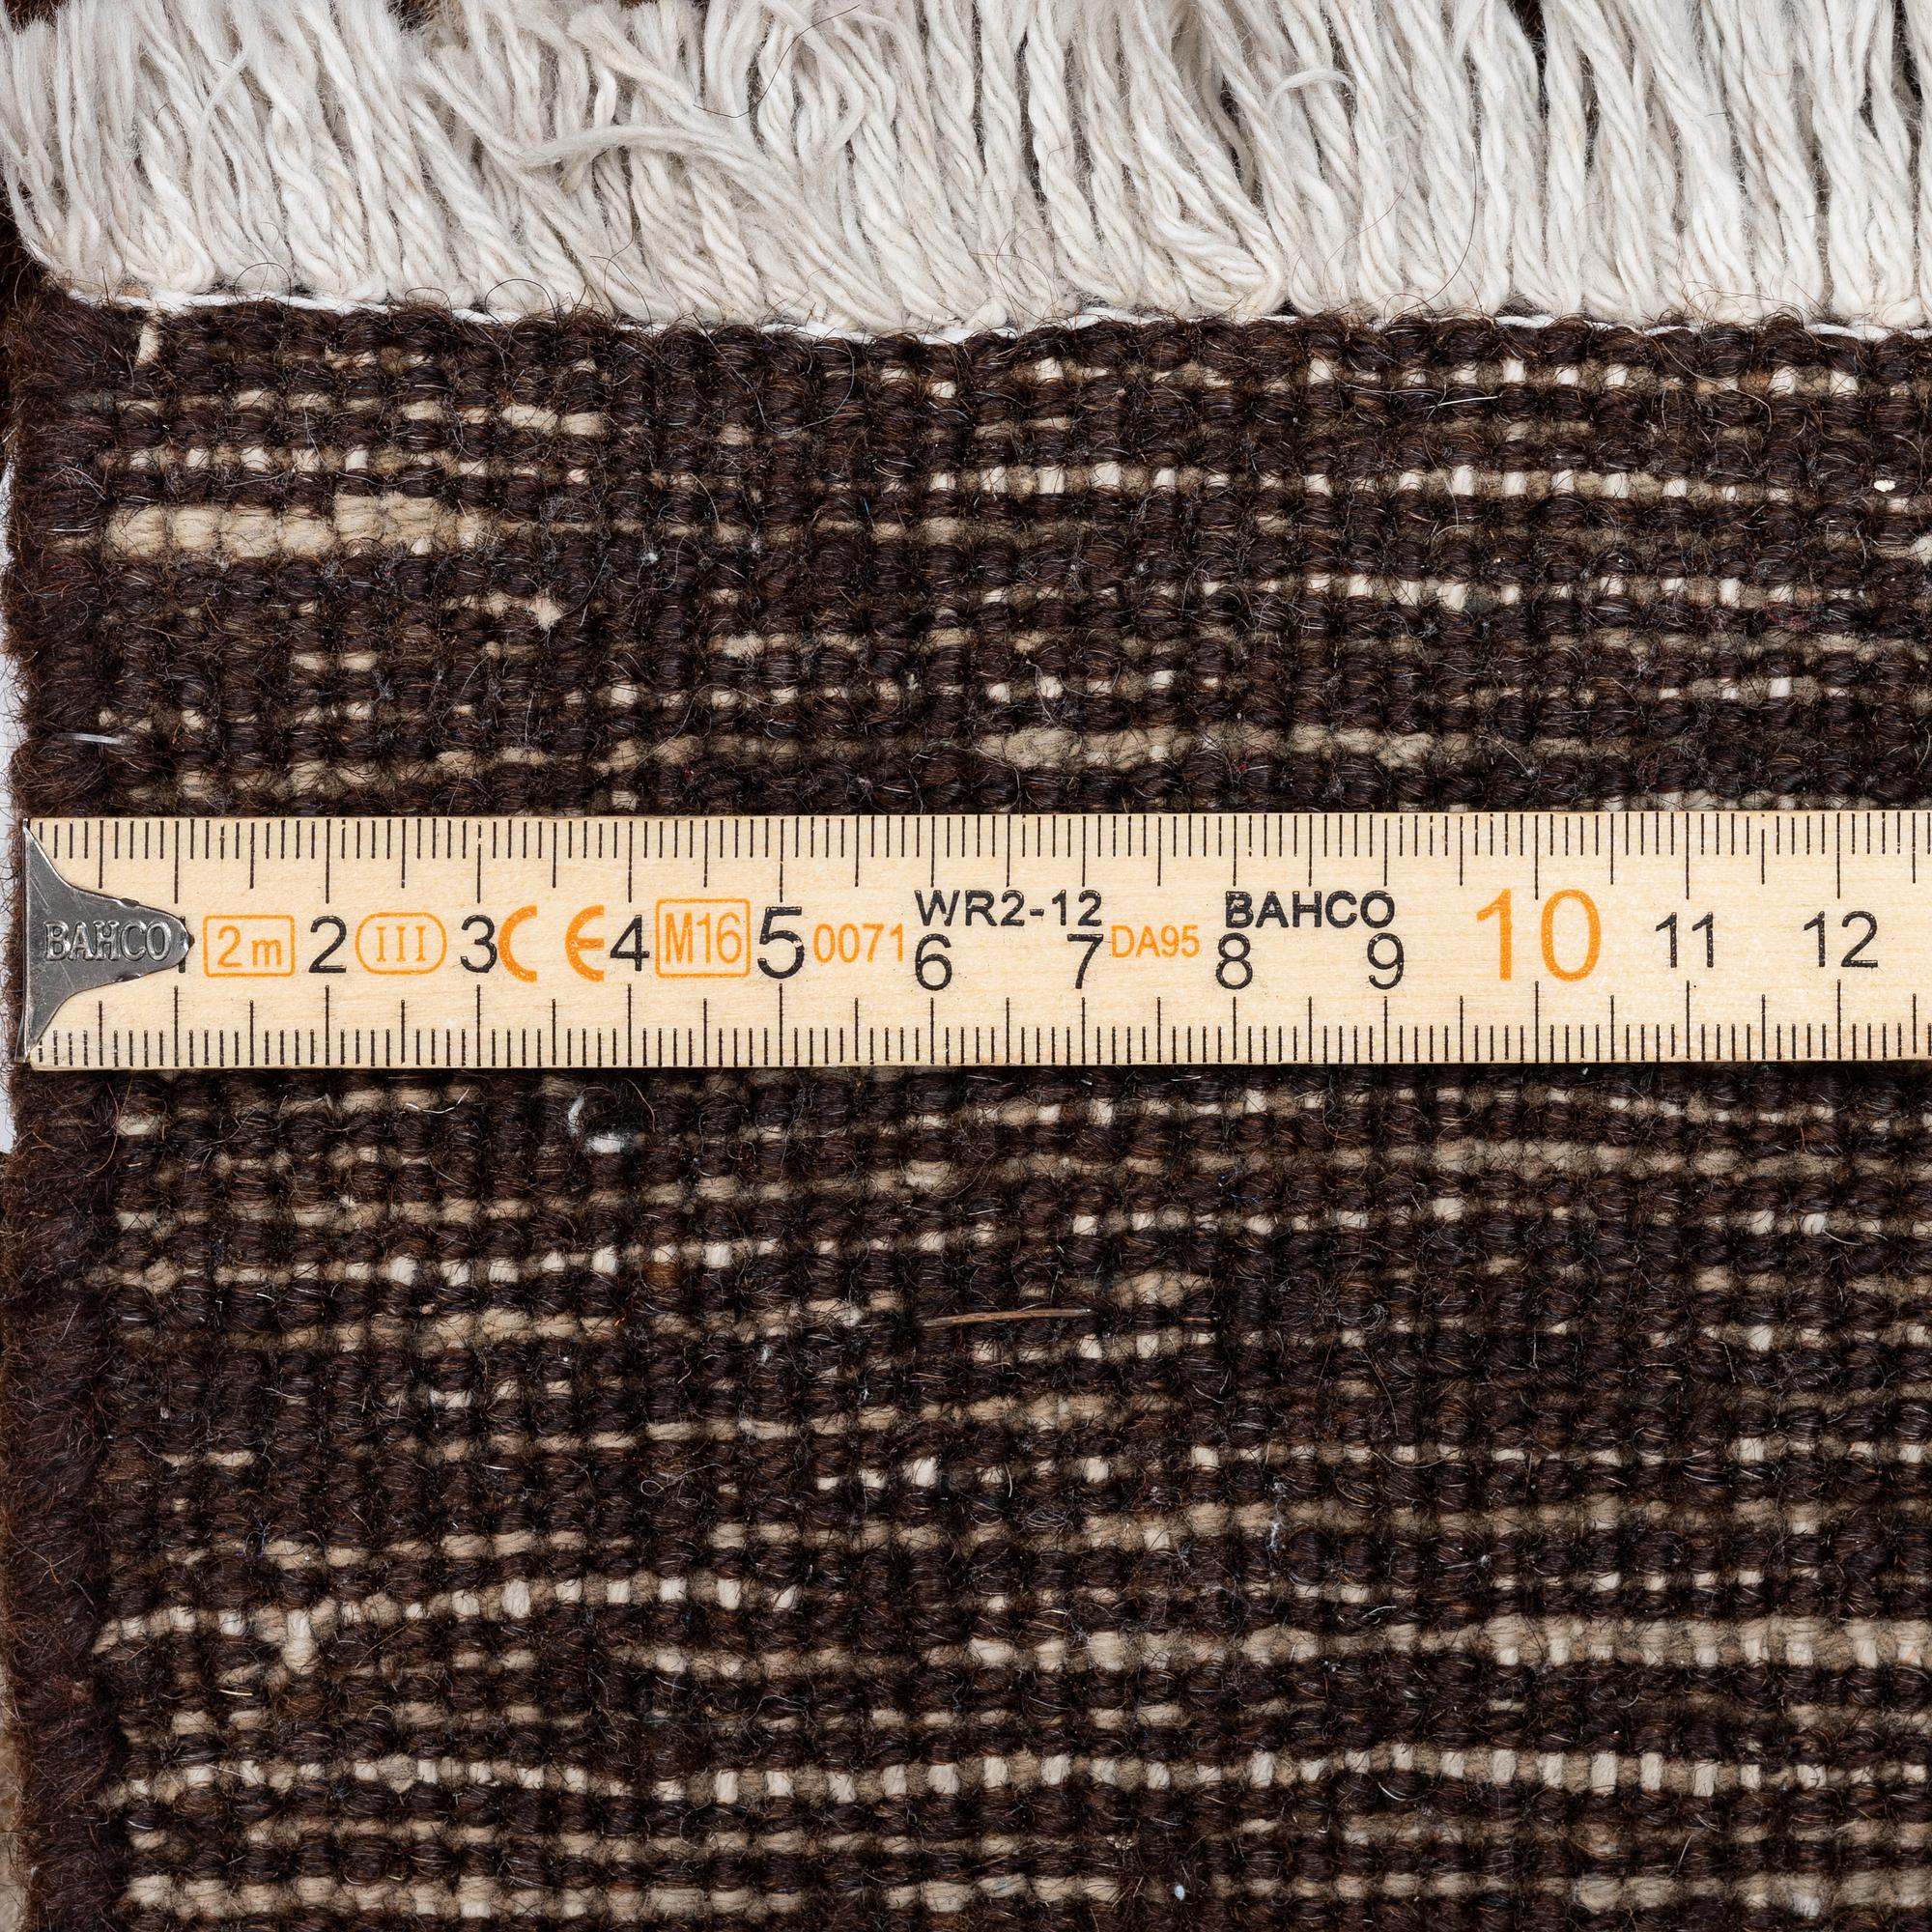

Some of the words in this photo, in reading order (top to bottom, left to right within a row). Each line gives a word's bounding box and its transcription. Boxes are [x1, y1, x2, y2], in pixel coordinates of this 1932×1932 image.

[915, 889, 1102, 927] WR2-12
[1225, 890, 1396, 928] BAHCO
[1476, 888, 1602, 982] 10
[44, 921, 172, 961] BAHCO
[308, 915, 347, 974] 2
[460, 915, 498, 974] 3
[610, 914, 650, 972] 4
[665, 911, 743, 964] M16
[756, 906, 806, 980] 5
[813, 923, 904, 964] 0071
[914, 933, 952, 991] 6
[1066, 933, 1104, 990] 7
[1109, 923, 1201, 958] DA95
[1214, 932, 1254, 990] 8
[1367, 932, 1405, 990] 9
[1655, 911, 1714, 969] 11
[1804, 910, 1879, 969] 12
